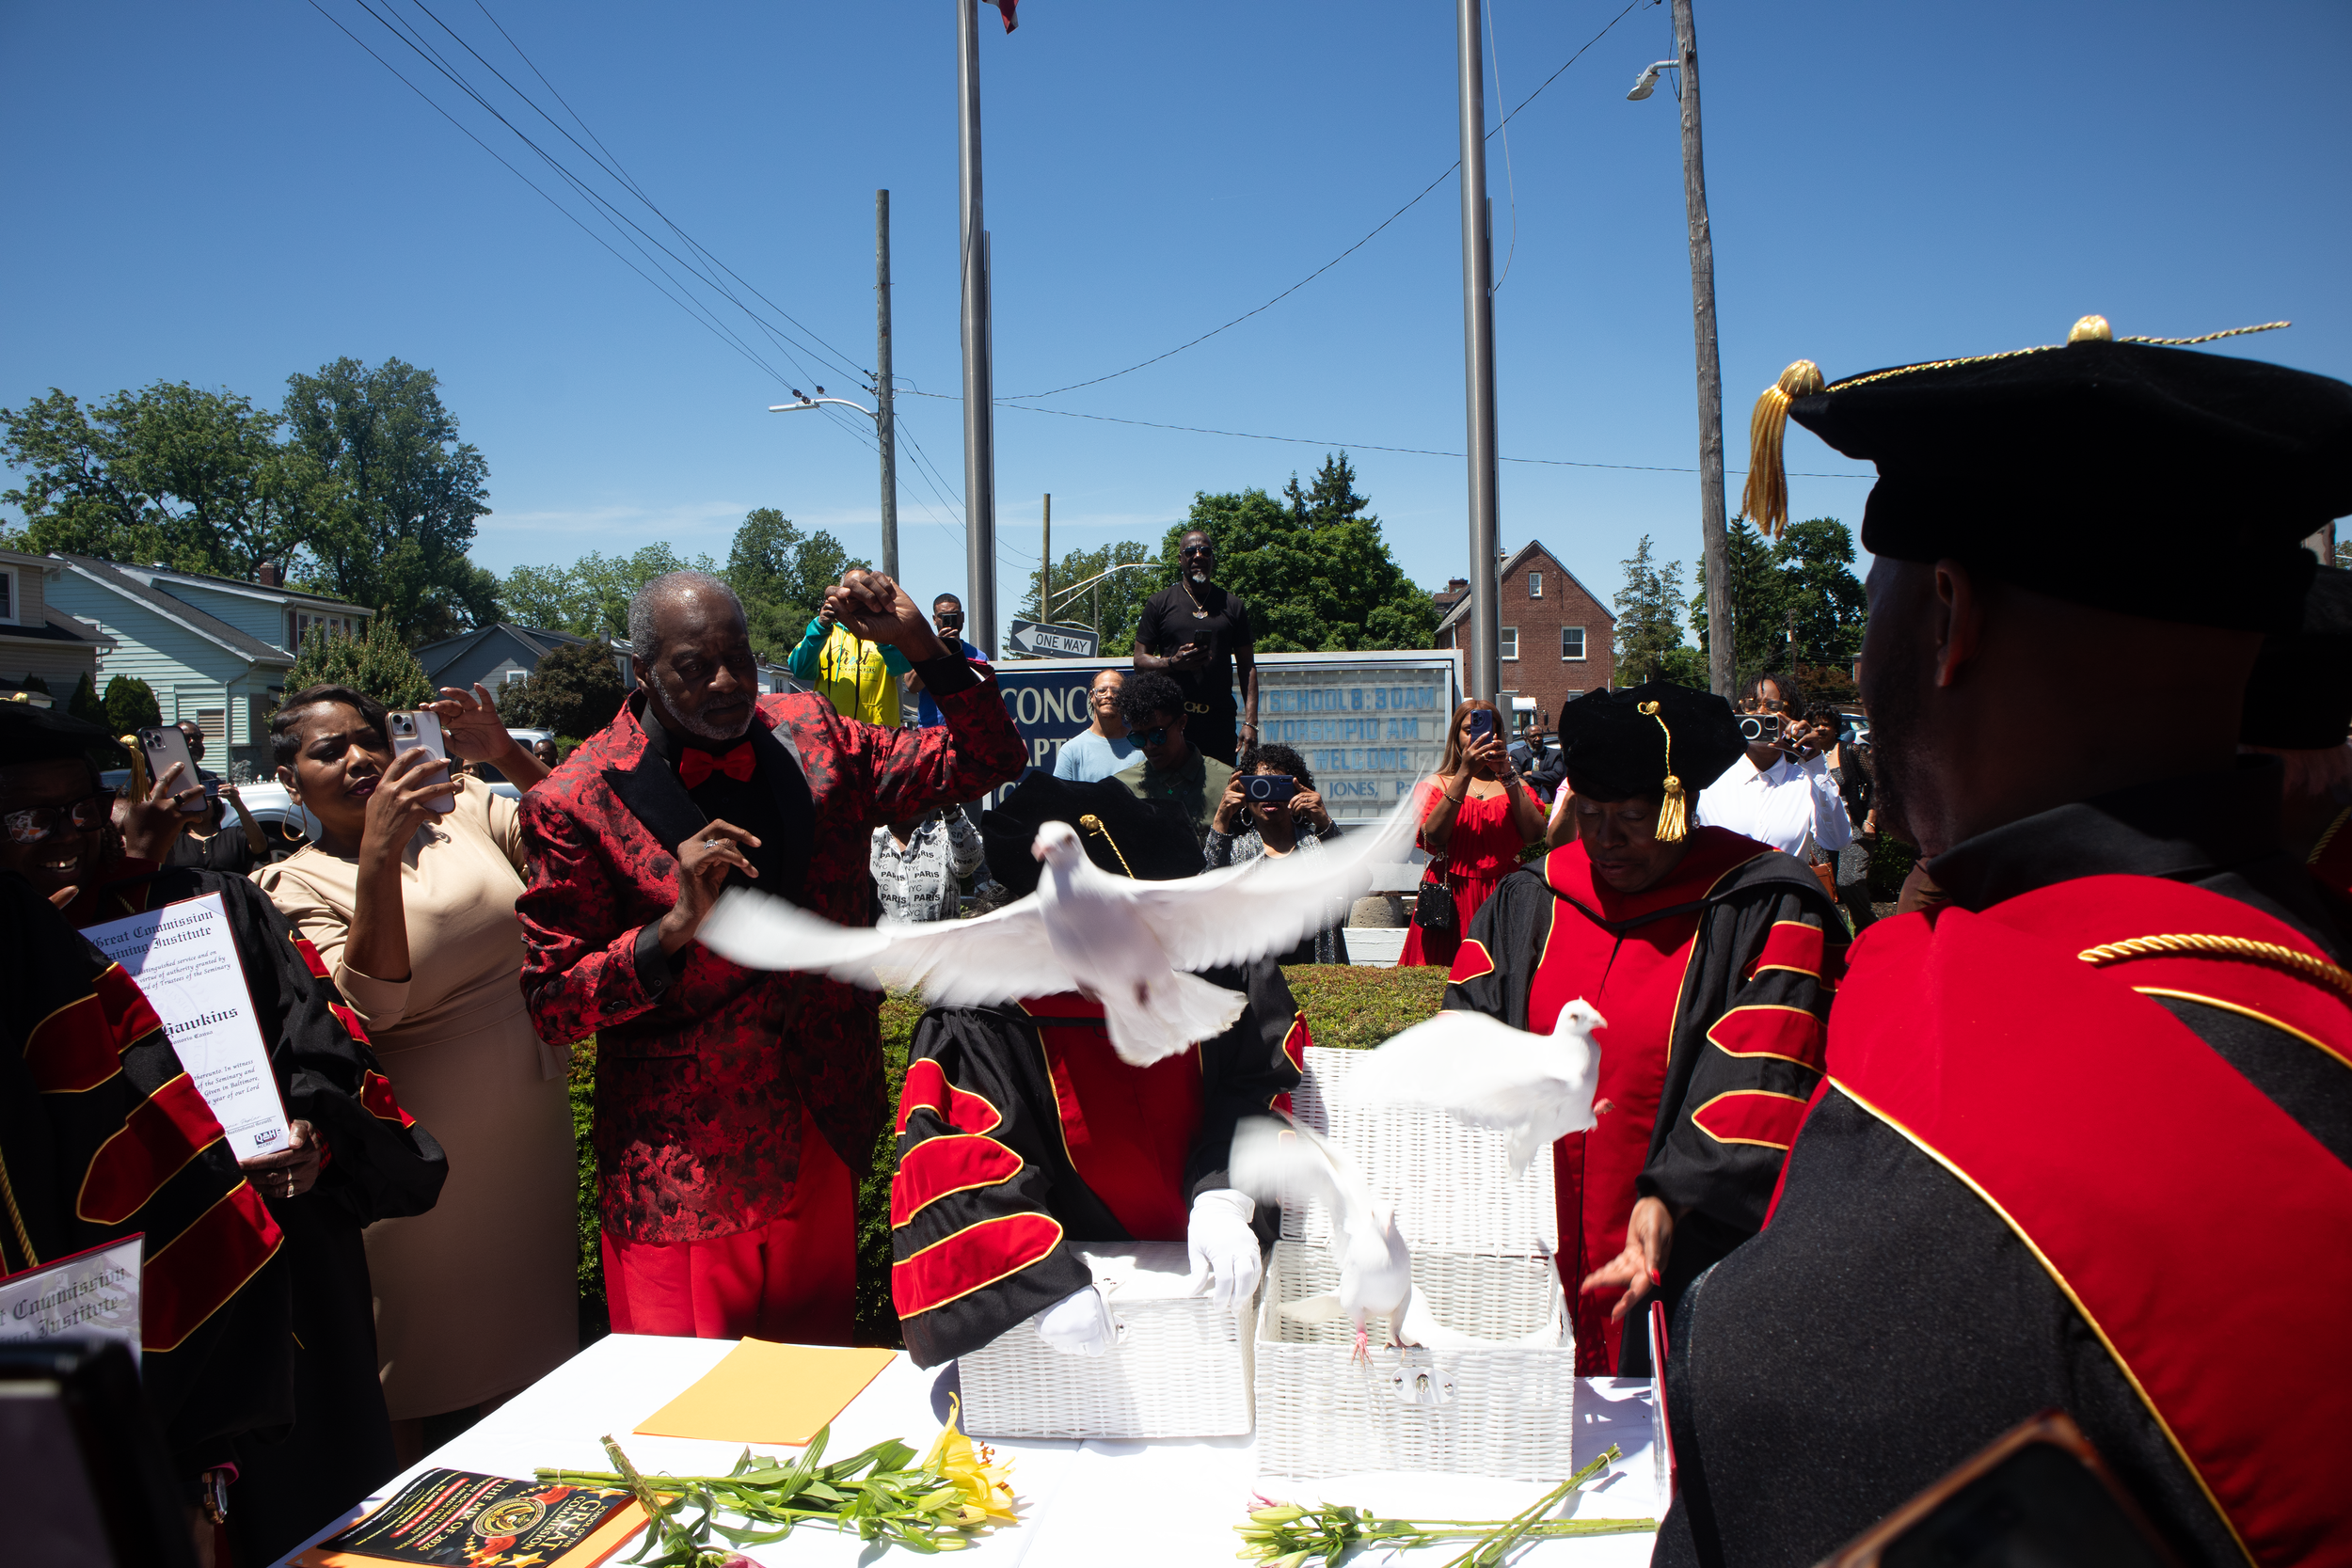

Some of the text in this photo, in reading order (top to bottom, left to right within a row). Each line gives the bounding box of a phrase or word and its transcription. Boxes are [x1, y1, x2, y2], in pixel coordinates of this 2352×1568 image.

[1036, 633, 1088, 656] ONE WAY
[1000, 686, 1094, 724] CONC
[1270, 689, 1349, 712] SCHOOL
[1263, 720, 1357, 741] WORSHIP
[1387, 717, 1418, 739] AM
[1312, 748, 1408, 770] WELCOME
[1329, 782, 1378, 799] JONES,
[873, 861, 888, 869] NYC
[881, 871, 905, 881] PARIS
[914, 870, 940, 879] PARIS
[881, 894, 907, 904] PARIS
[914, 894, 940, 902] PARIS
[133, 911, 214, 939] Commission
[104, 927, 212, 961] raining Institute
[137, 960, 176, 975] distinguished
[177, 955, 197, 965] service
[198, 951, 209, 959] and
[139, 974, 158, 984] virtue
[158, 970, 166, 980] of
[167, 964, 194, 976] authority
[195, 958, 218, 972] granted
[218, 956, 226, 965] by
[152, 980, 159, 990] of
[159, 974, 185, 987] Trustees
[185, 972, 193, 981] of
[194, 969, 202, 977] the
[203, 963, 231, 976] Seminary
[162, 1008, 238, 1038] Hawkins
[232, 1060, 254, 1069] witness
[197, 1081, 203, 1090] of
[215, 1070, 243, 1085] Seminary
[245, 1066, 255, 1074] and
[204, 1088, 221, 1099] Given
[212, 1096, 226, 1106] year
[227, 1092, 233, 1102] of
[234, 1088, 246, 1097] our
[246, 1083, 260, 1093] Lord
[13, 1267, 126, 1321] Commission
[38, 1295, 119, 1340] Institute
[481, 1484, 509, 1500] THE
[435, 1493, 471, 1523] DOCTORATE
[459, 1501, 485, 1520] MIX
[582, 1505, 609, 1528] SCHOOL
[445, 1522, 464, 1534] OF
[522, 1496, 586, 1550] COMMISSION
[539, 1500, 601, 1550] GREAT
[395, 1523, 437, 1549] GRADUATION
[419, 1534, 448, 1551] 2026
